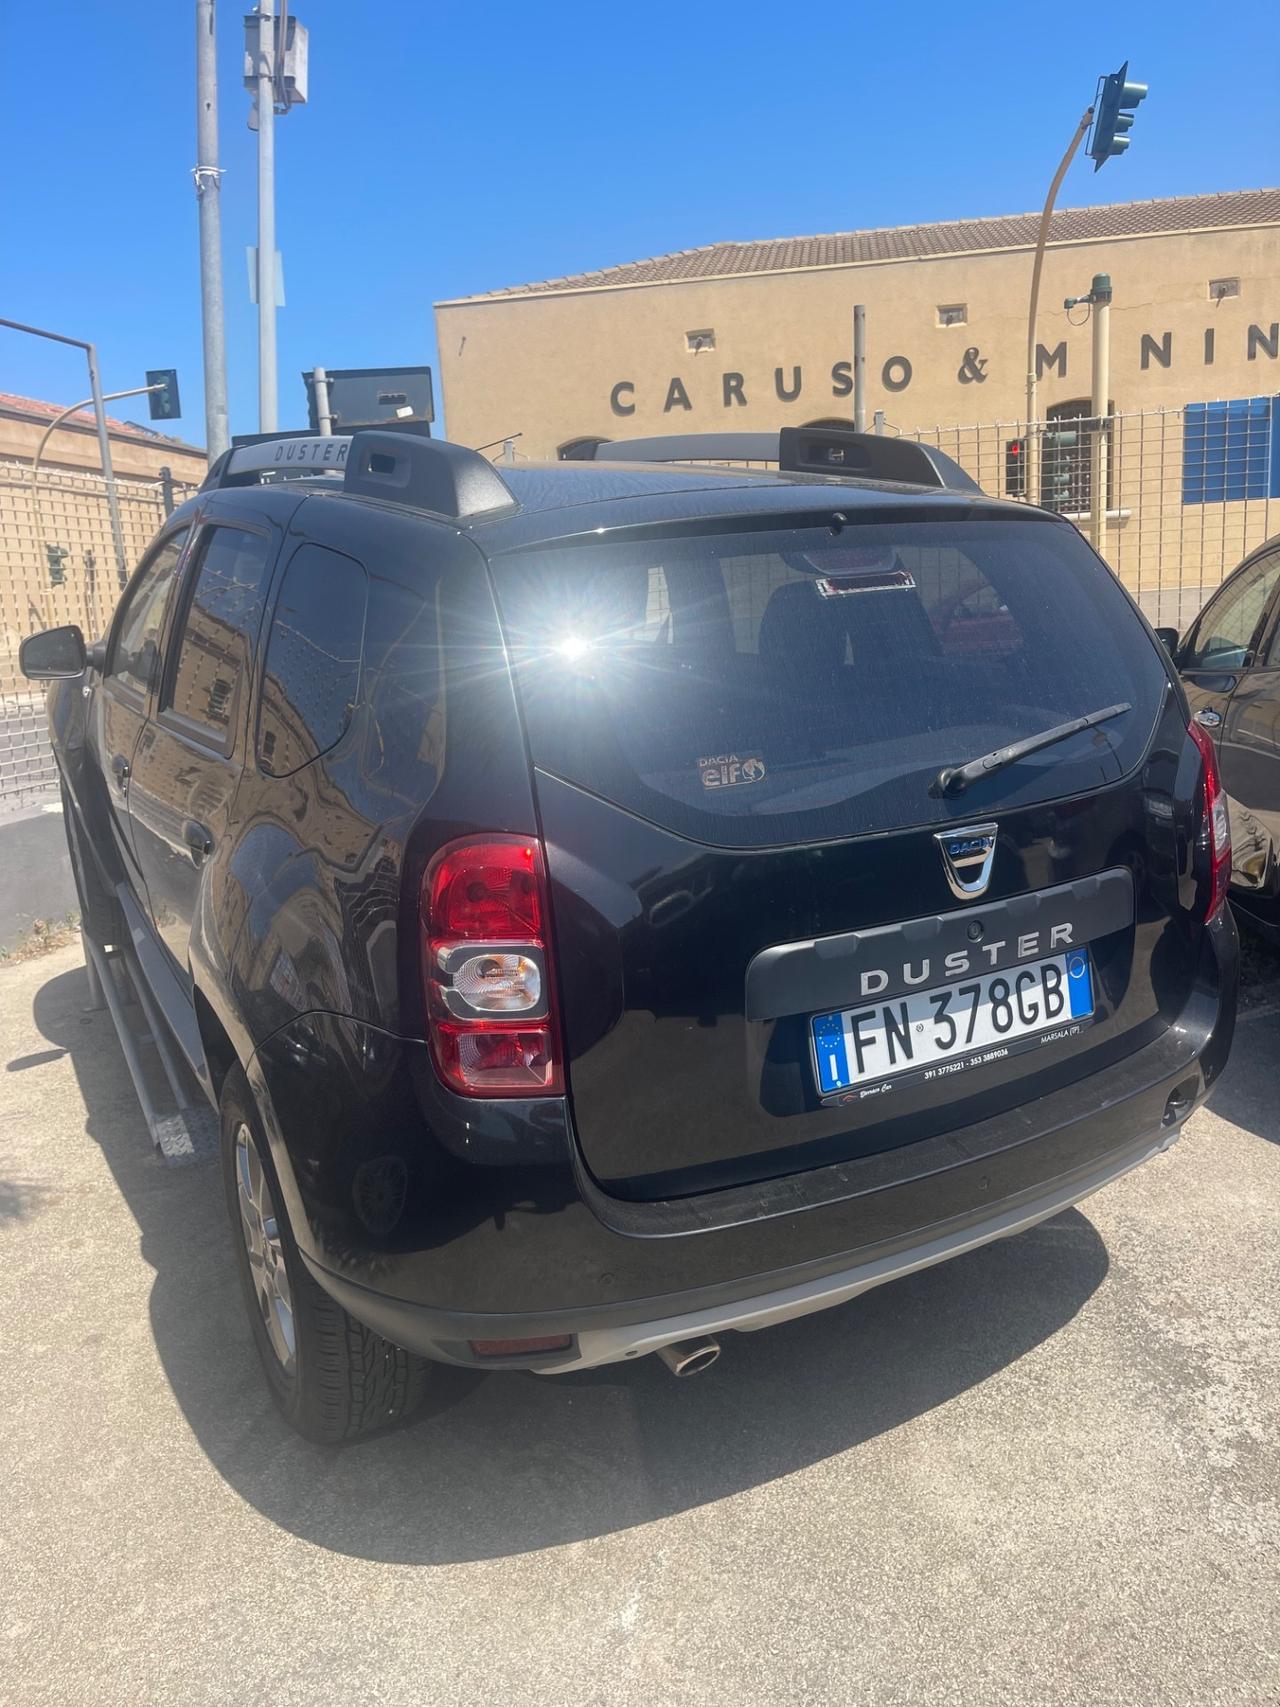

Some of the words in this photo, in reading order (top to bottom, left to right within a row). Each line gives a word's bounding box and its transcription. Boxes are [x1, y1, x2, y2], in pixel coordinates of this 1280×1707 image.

[609, 355, 912, 417] CARUSO
[957, 346, 989, 386] &
[1035, 322, 1279, 382] MNIN
[274, 443, 348, 462] DUSTER
[699, 754, 739, 767] DACIA
[860, 922, 1074, 996] DUSTER
[850, 1002, 914, 1074] FN
[929, 963, 1065, 1050] 378GB
[1040, 1029, 1069, 1044] MARSALA
[924, 1070, 936, 1079] 391
[938, 1061, 965, 1076] 3775221
